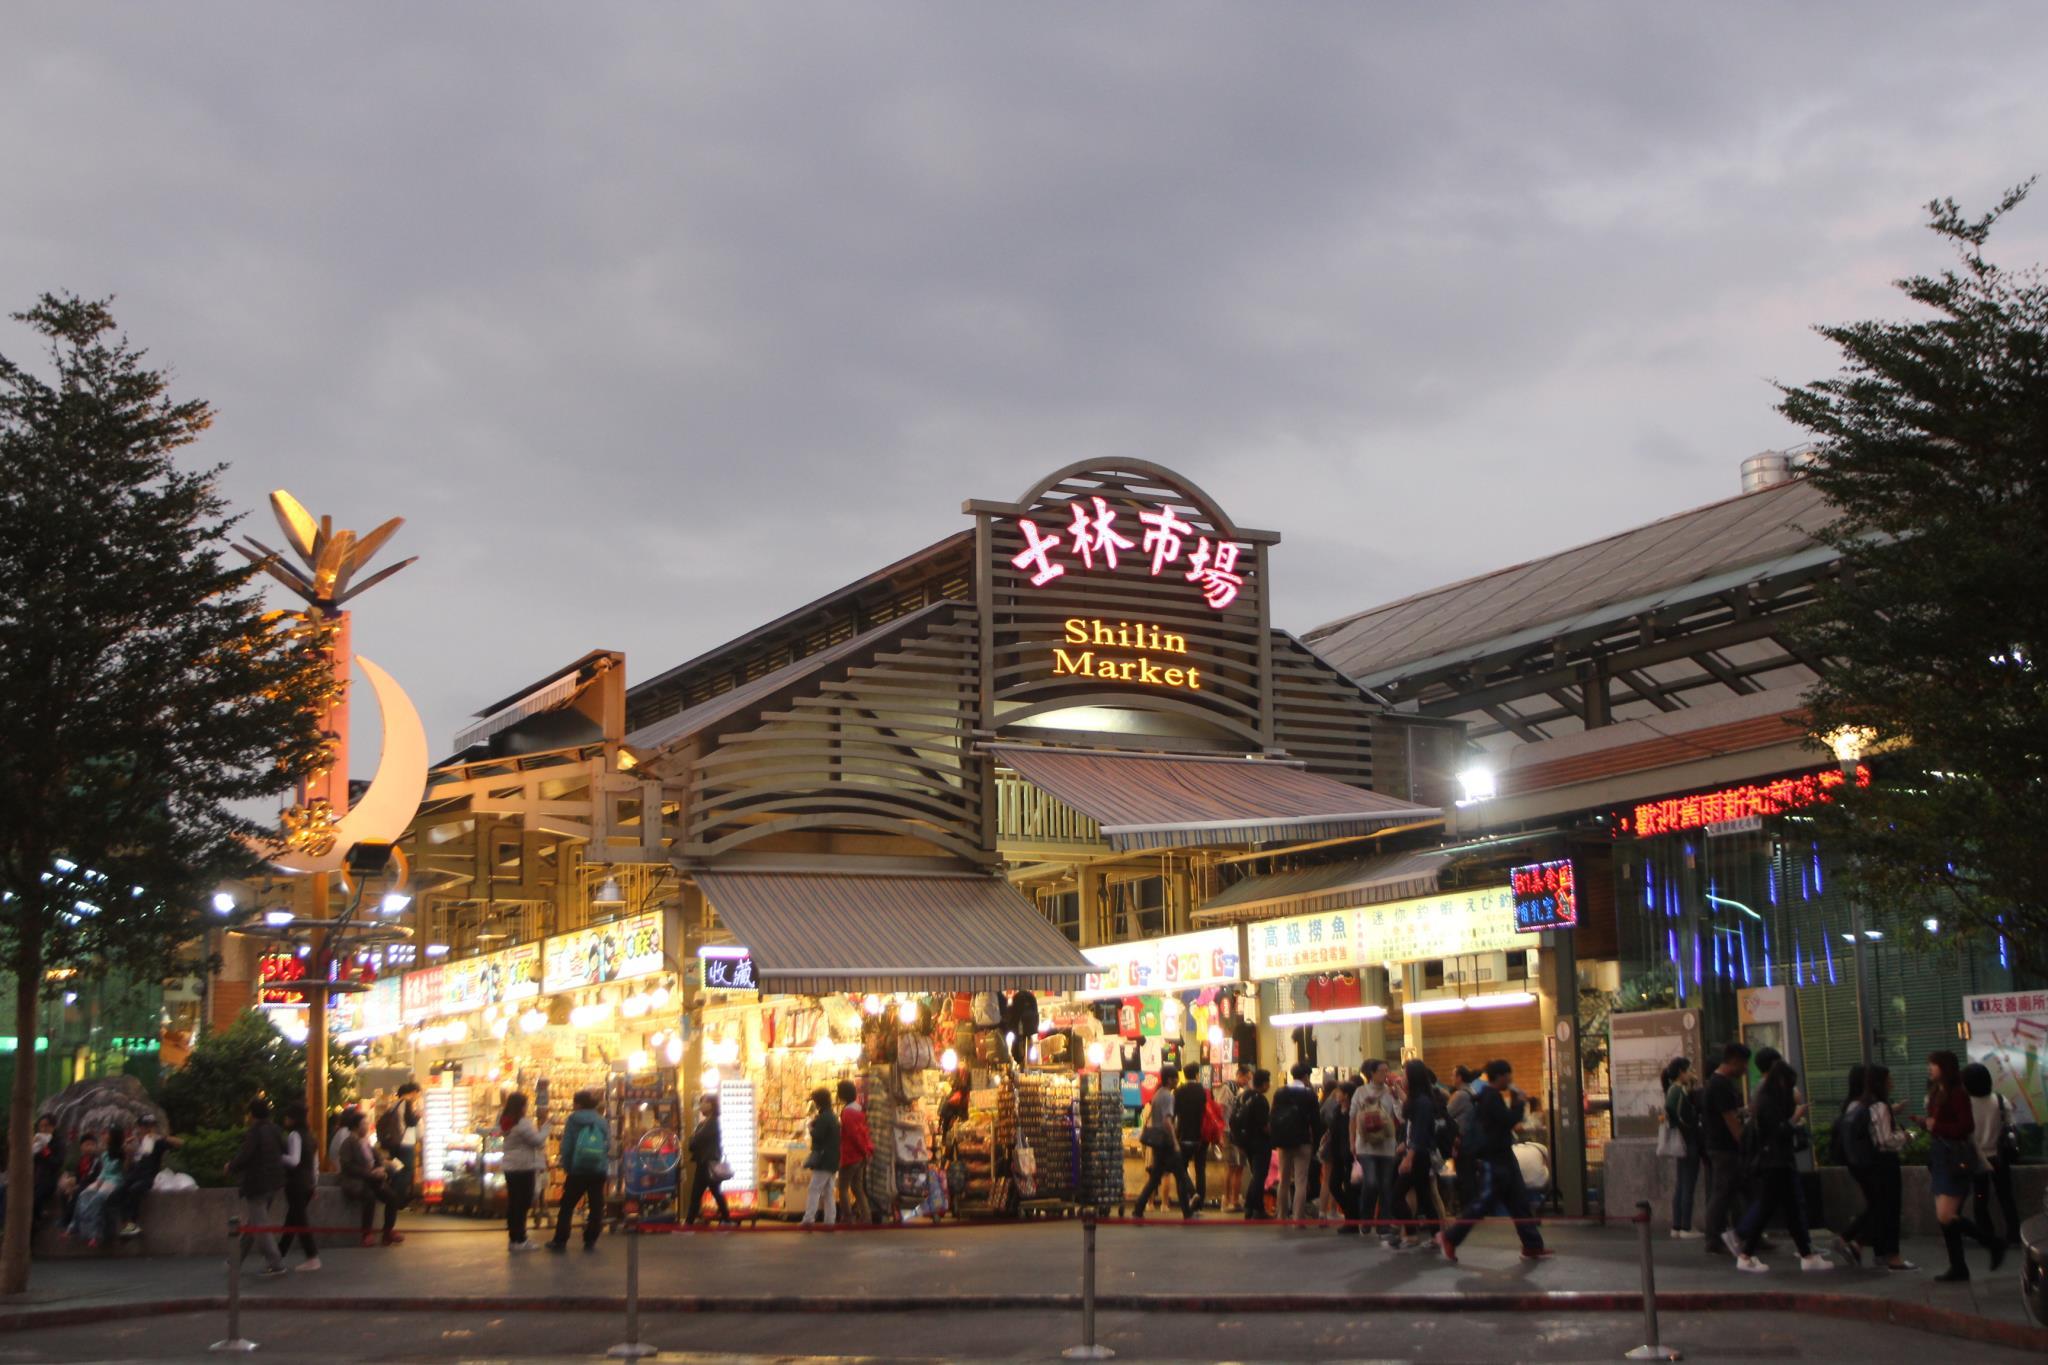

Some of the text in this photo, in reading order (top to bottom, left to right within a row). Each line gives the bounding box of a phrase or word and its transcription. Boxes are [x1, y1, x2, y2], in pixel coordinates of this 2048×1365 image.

[1011, 496, 1243, 609] 士林市場
[1065, 618, 1187, 654] Shilin
[1052, 648, 1201, 689] Market
[1264, 915, 1347, 948] 高級撈魚
[709, 958, 756, 988] 收藏
[1991, 993, 2047, 1013] 友善廁所
